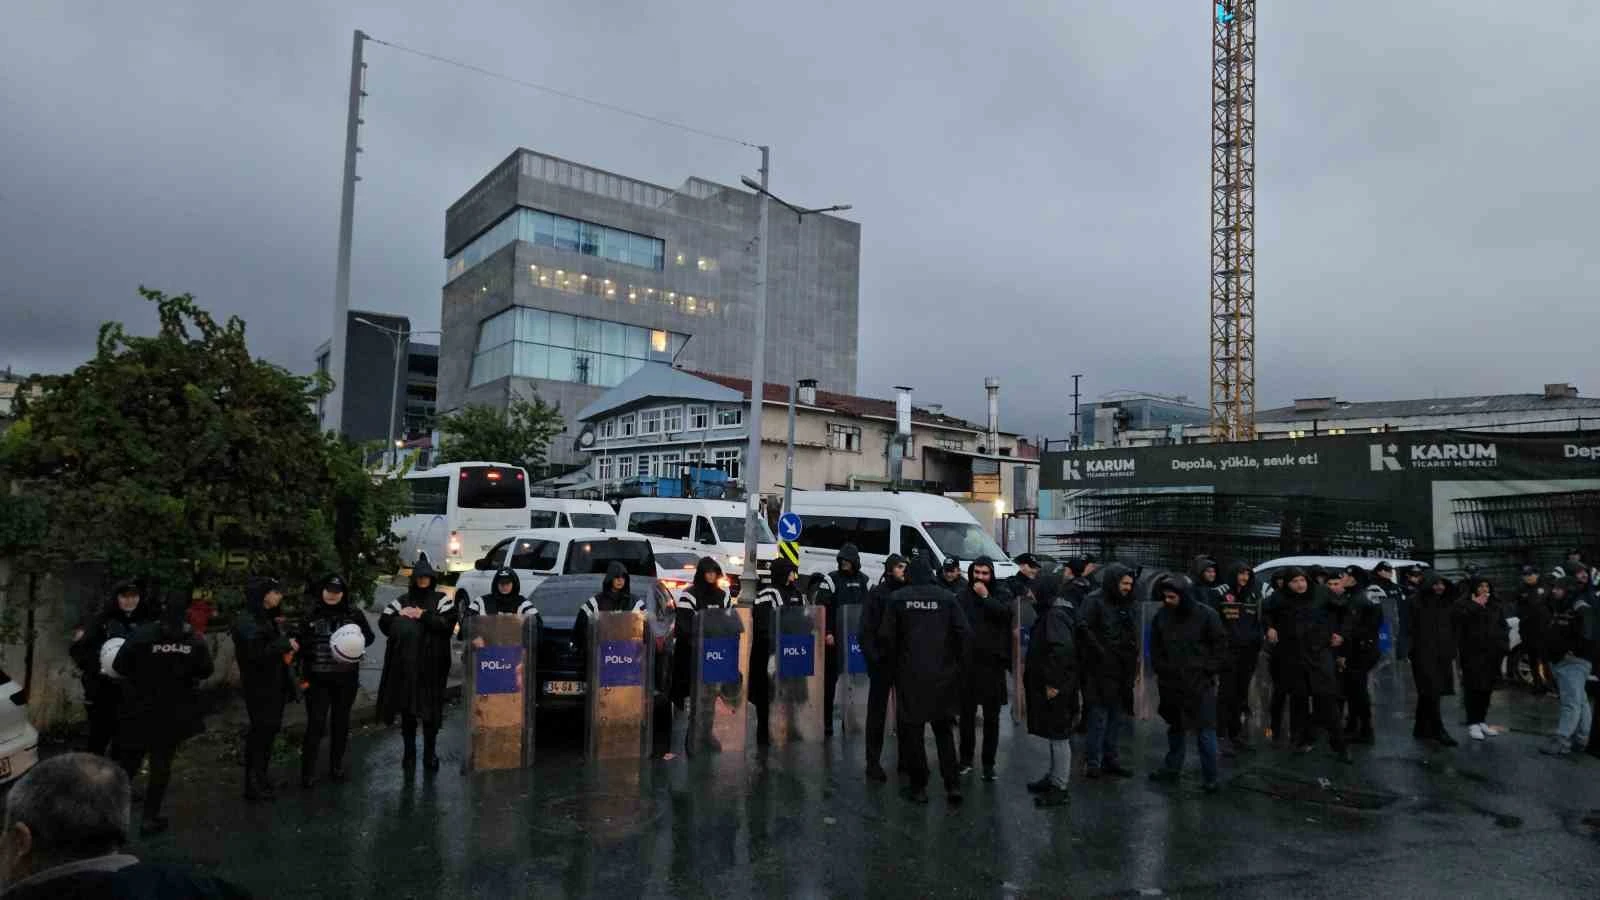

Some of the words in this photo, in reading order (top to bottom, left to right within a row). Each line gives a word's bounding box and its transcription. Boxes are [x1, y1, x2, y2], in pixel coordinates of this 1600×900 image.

[1410, 443, 1497, 460] KARUM
[1086, 459, 1135, 472] KARUM
[1171, 458, 1216, 471] Depola,
[1220, 456, 1259, 470] yükle,
[1263, 454, 1295, 466] sevk
